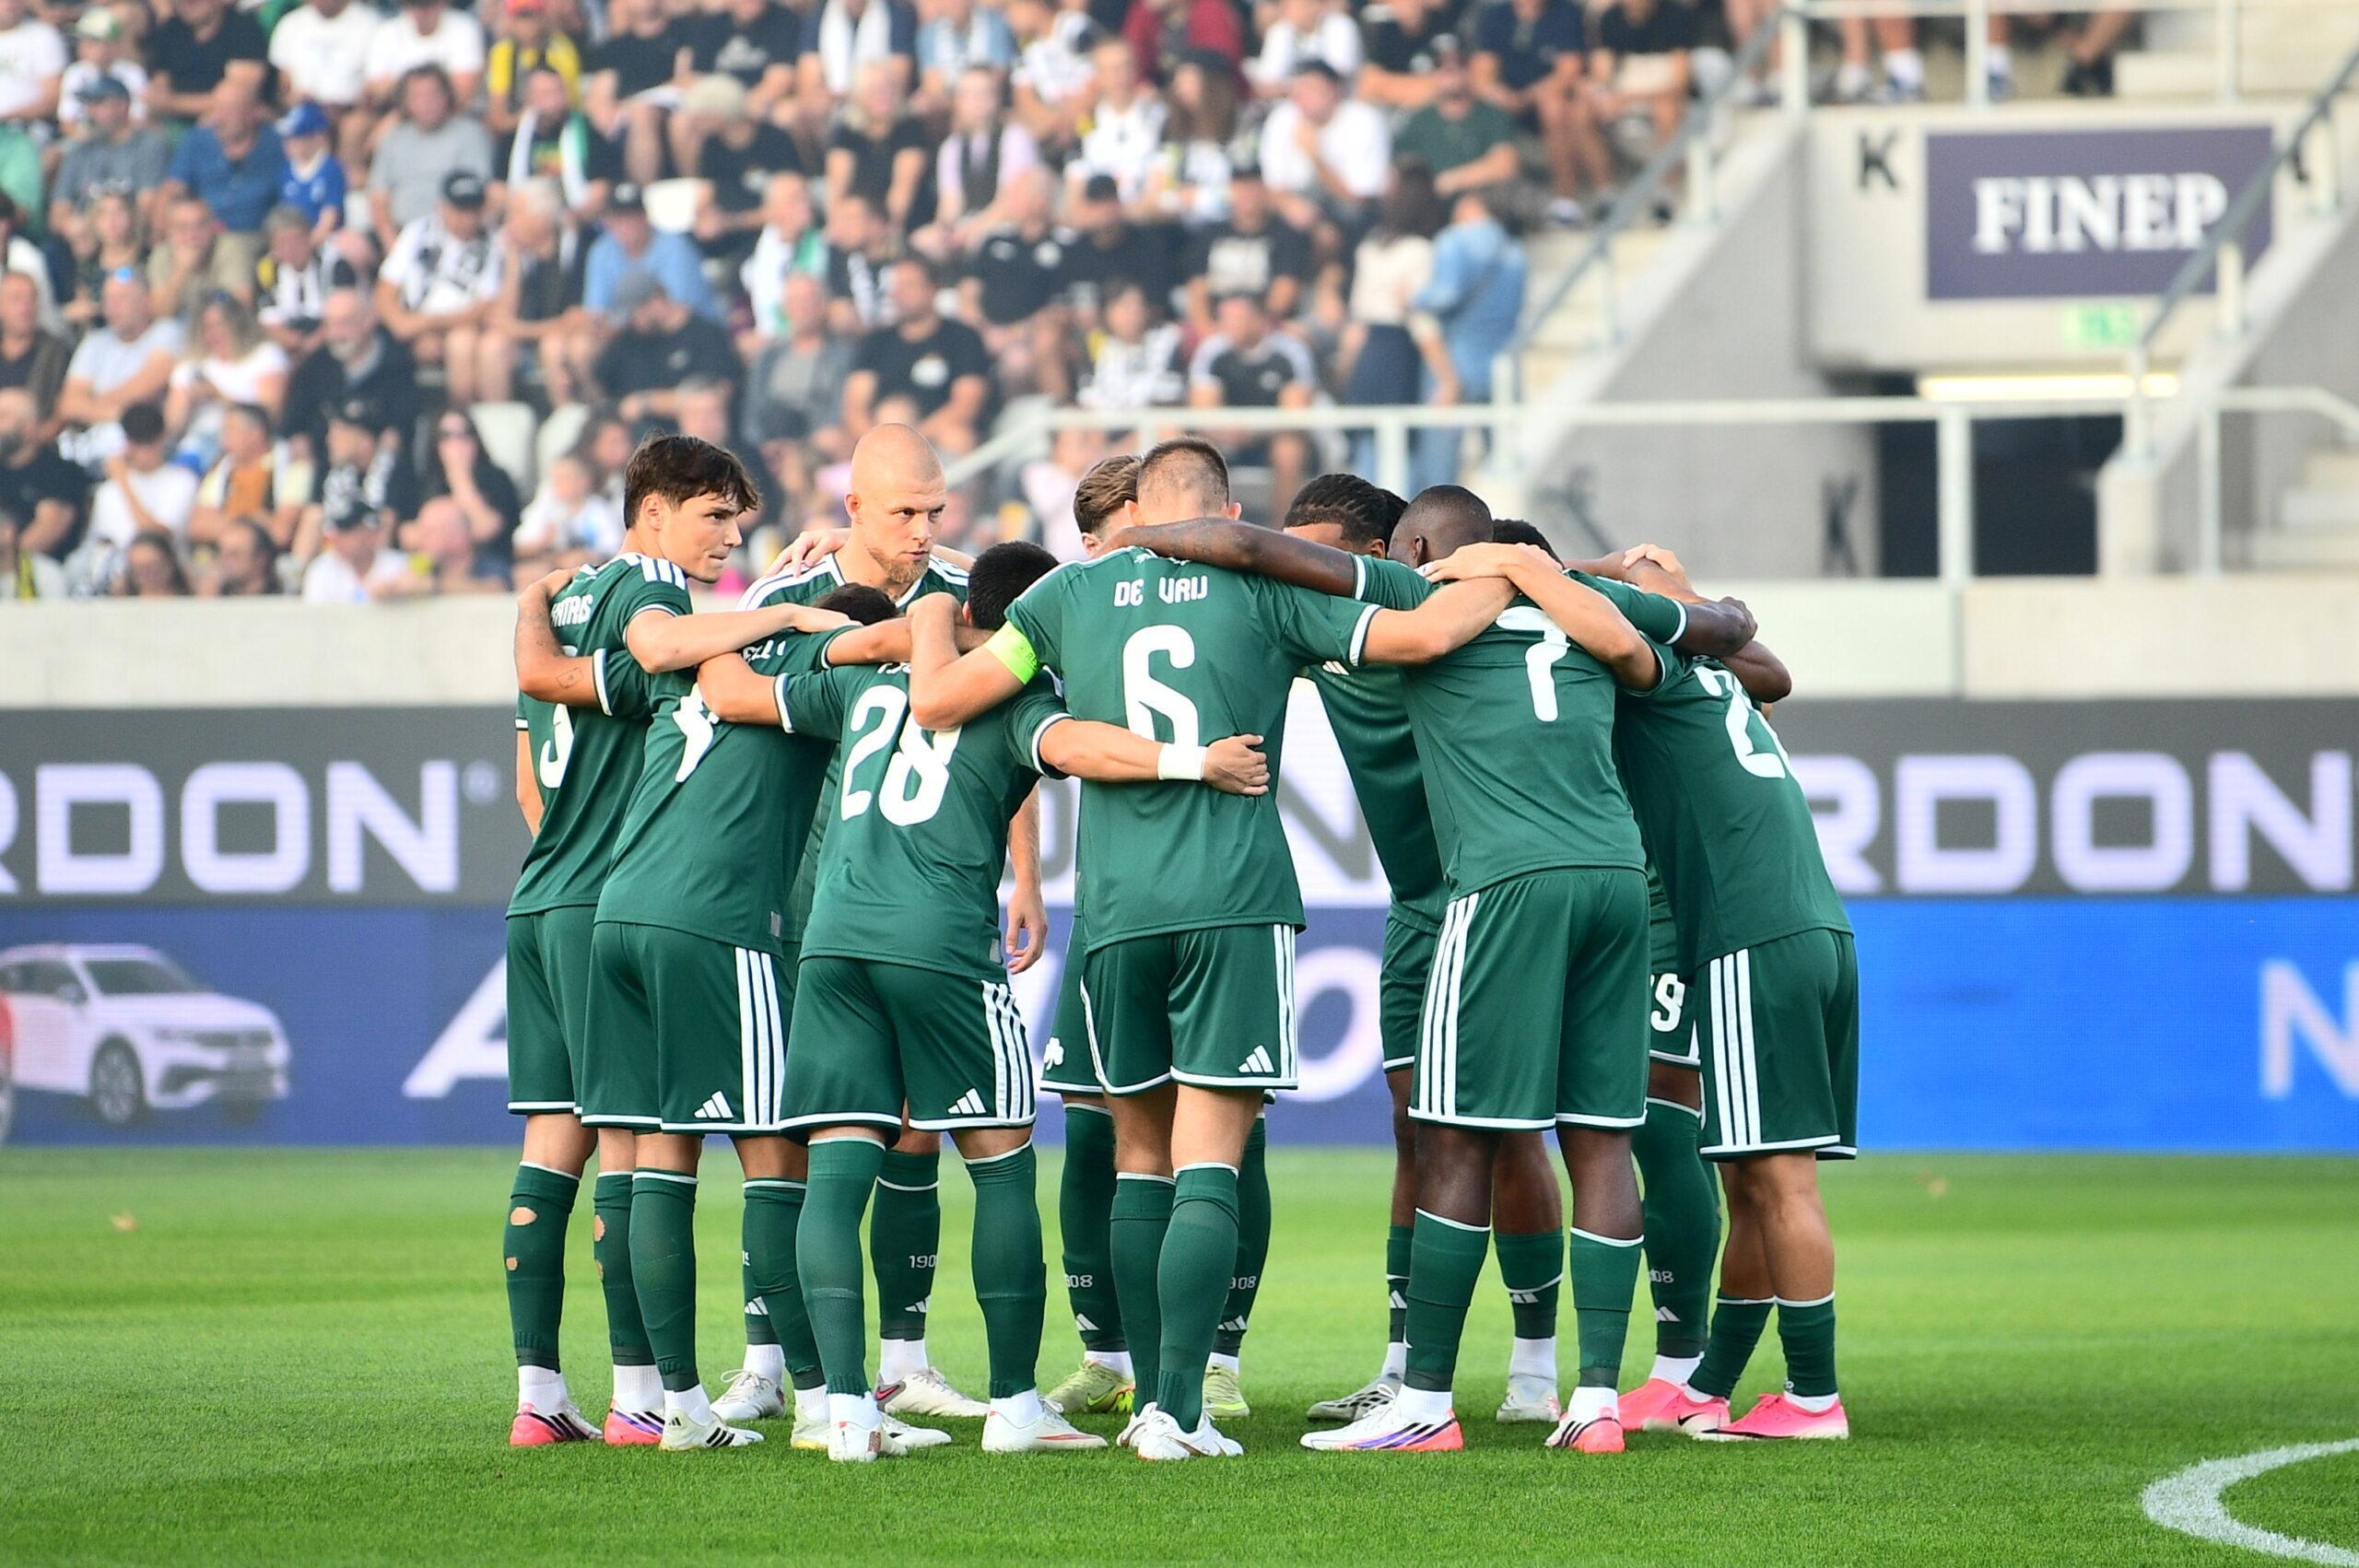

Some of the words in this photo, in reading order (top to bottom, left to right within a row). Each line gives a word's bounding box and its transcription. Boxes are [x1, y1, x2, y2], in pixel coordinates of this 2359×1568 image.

[1859, 129, 1899, 188] K
[1973, 172, 2229, 253] FINEP
[1113, 579, 1144, 607] DE
[1123, 625, 1199, 748] 6
[1496, 605, 1571, 722] 7
[840, 685, 962, 826] 28
[0, 761, 460, 895] DON
[1650, 973, 1685, 1032] 9
